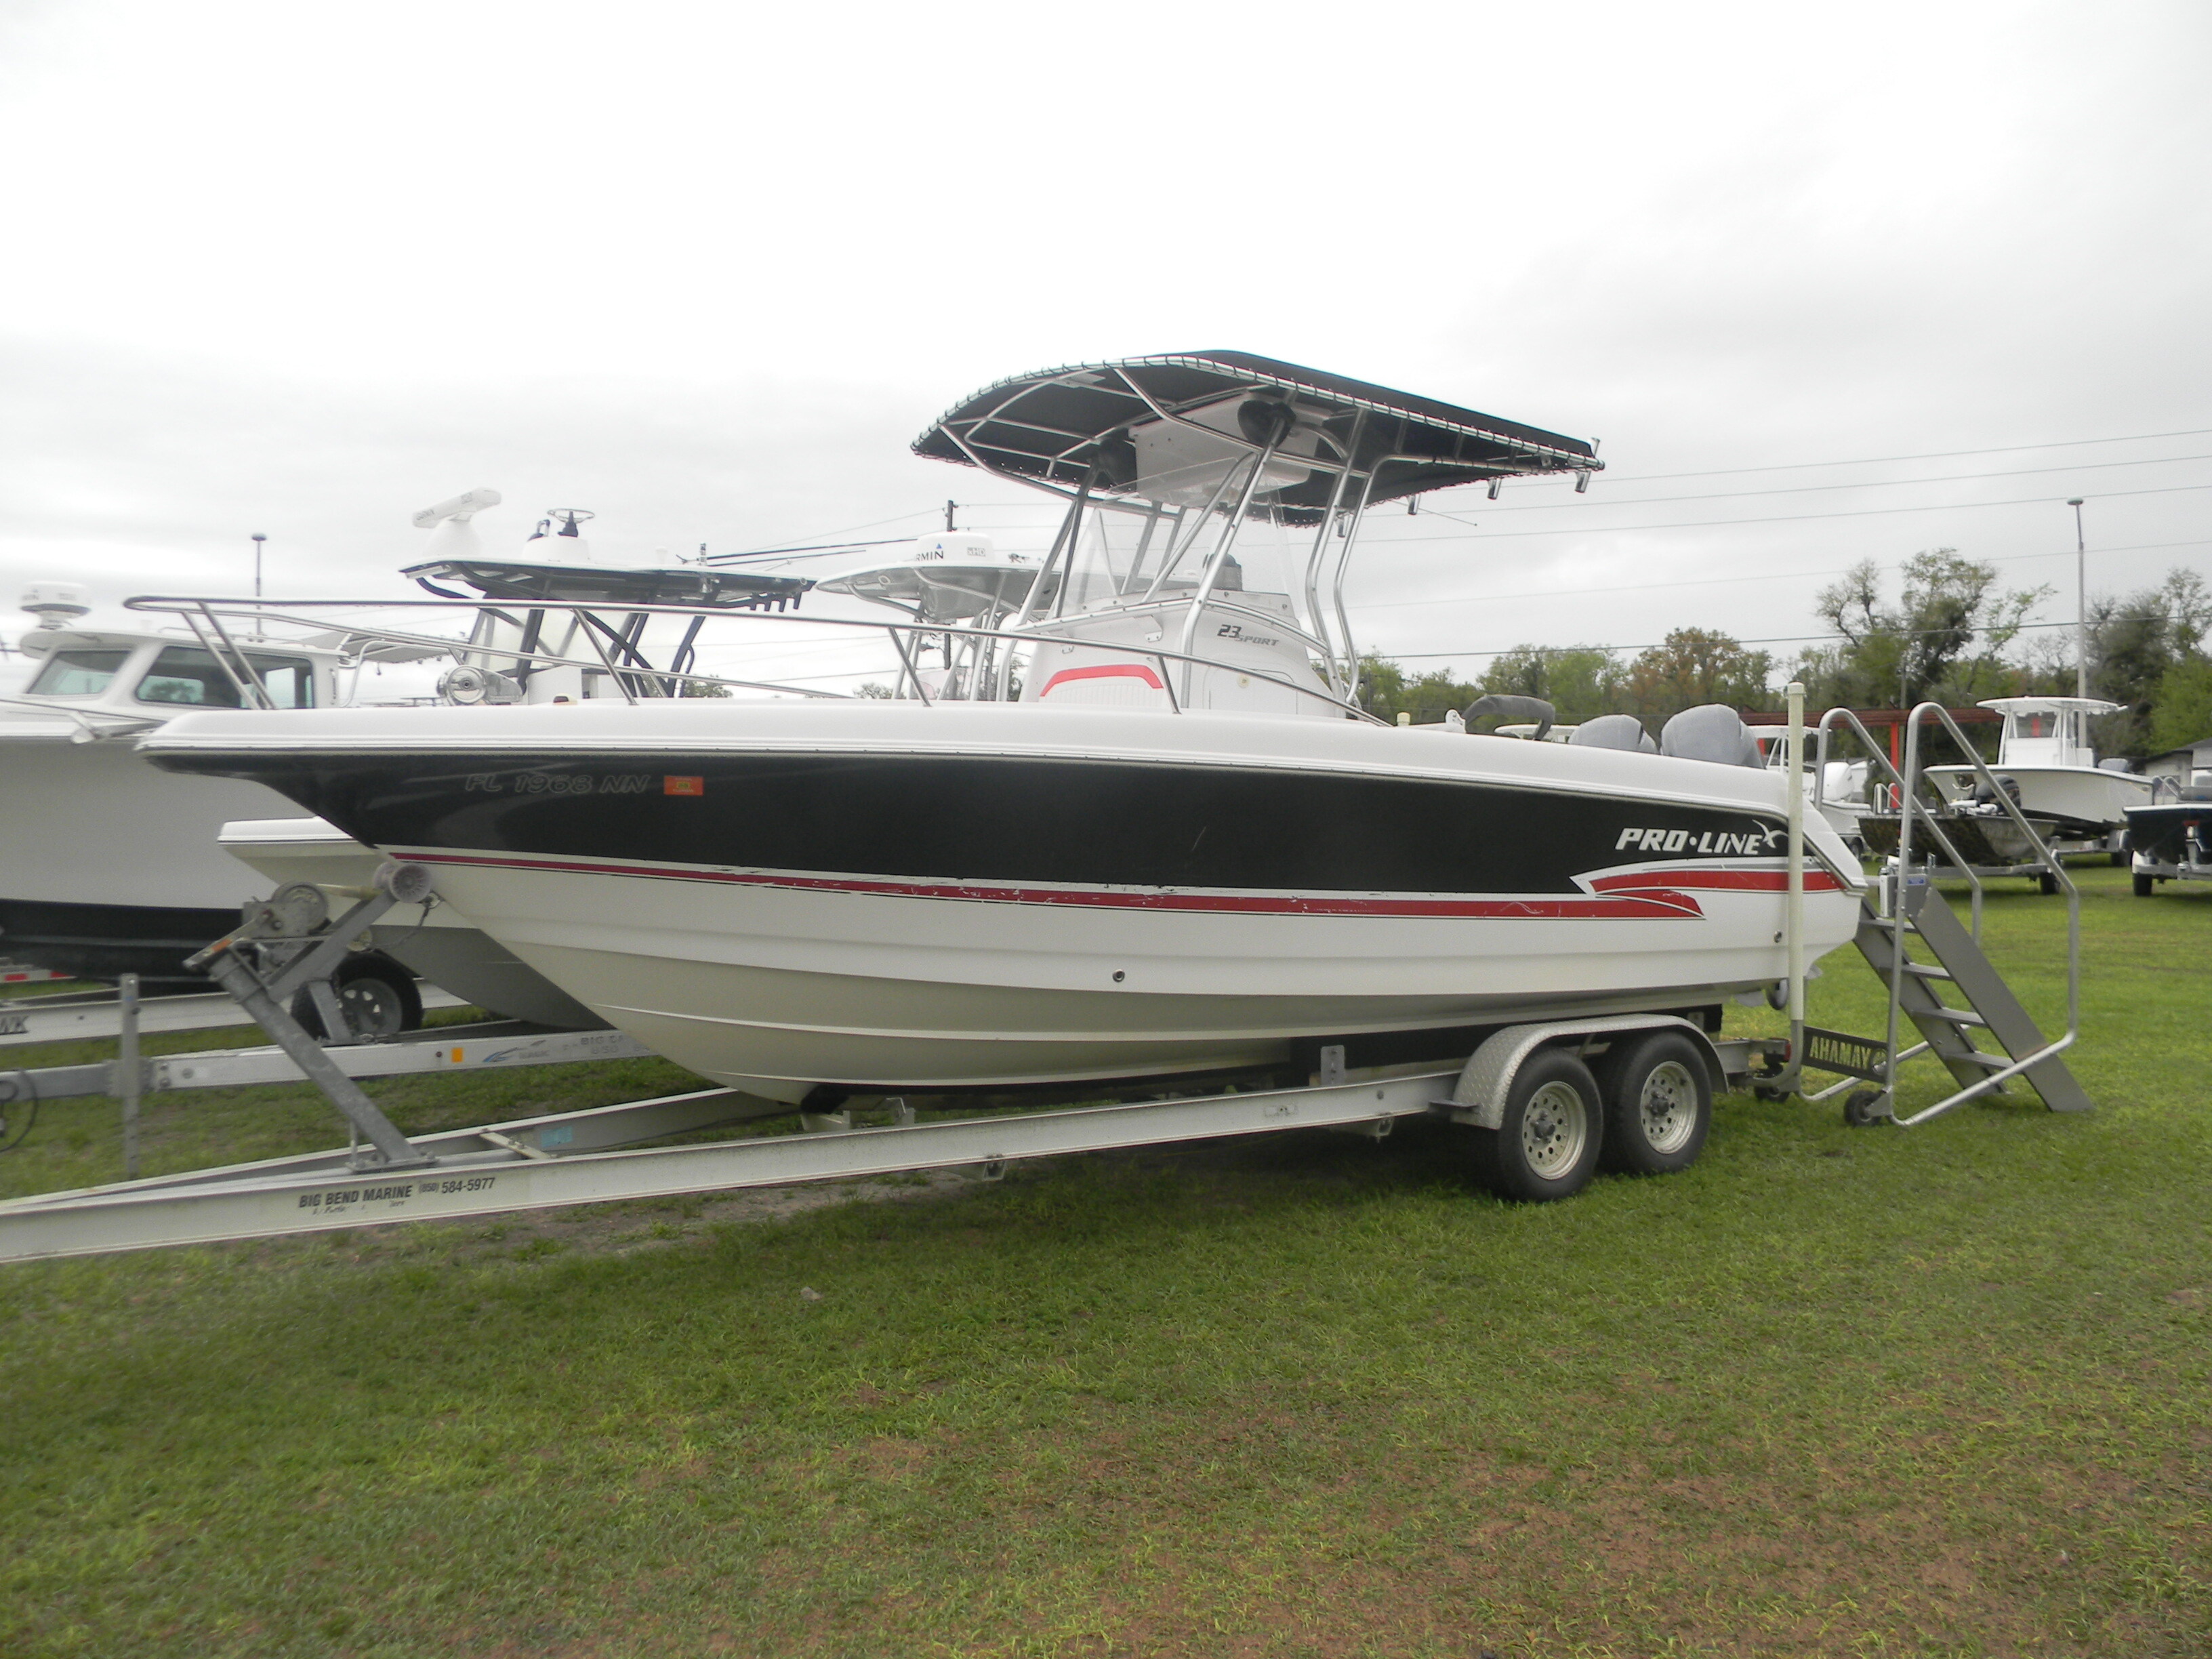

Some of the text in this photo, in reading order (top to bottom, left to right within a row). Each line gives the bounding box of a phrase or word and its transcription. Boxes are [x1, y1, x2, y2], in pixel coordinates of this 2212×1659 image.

[916, 550, 944, 562] RMIN
[1217, 624, 1279, 646] 23 SPORT
[465, 774, 651, 794] FL 1968 NN
[299, 1193, 321, 1208] BIG
[325, 1190, 360, 1206] BEND
[363, 1185, 413, 1202] MARINE
[442, 1177, 495, 1194] 584-5977
